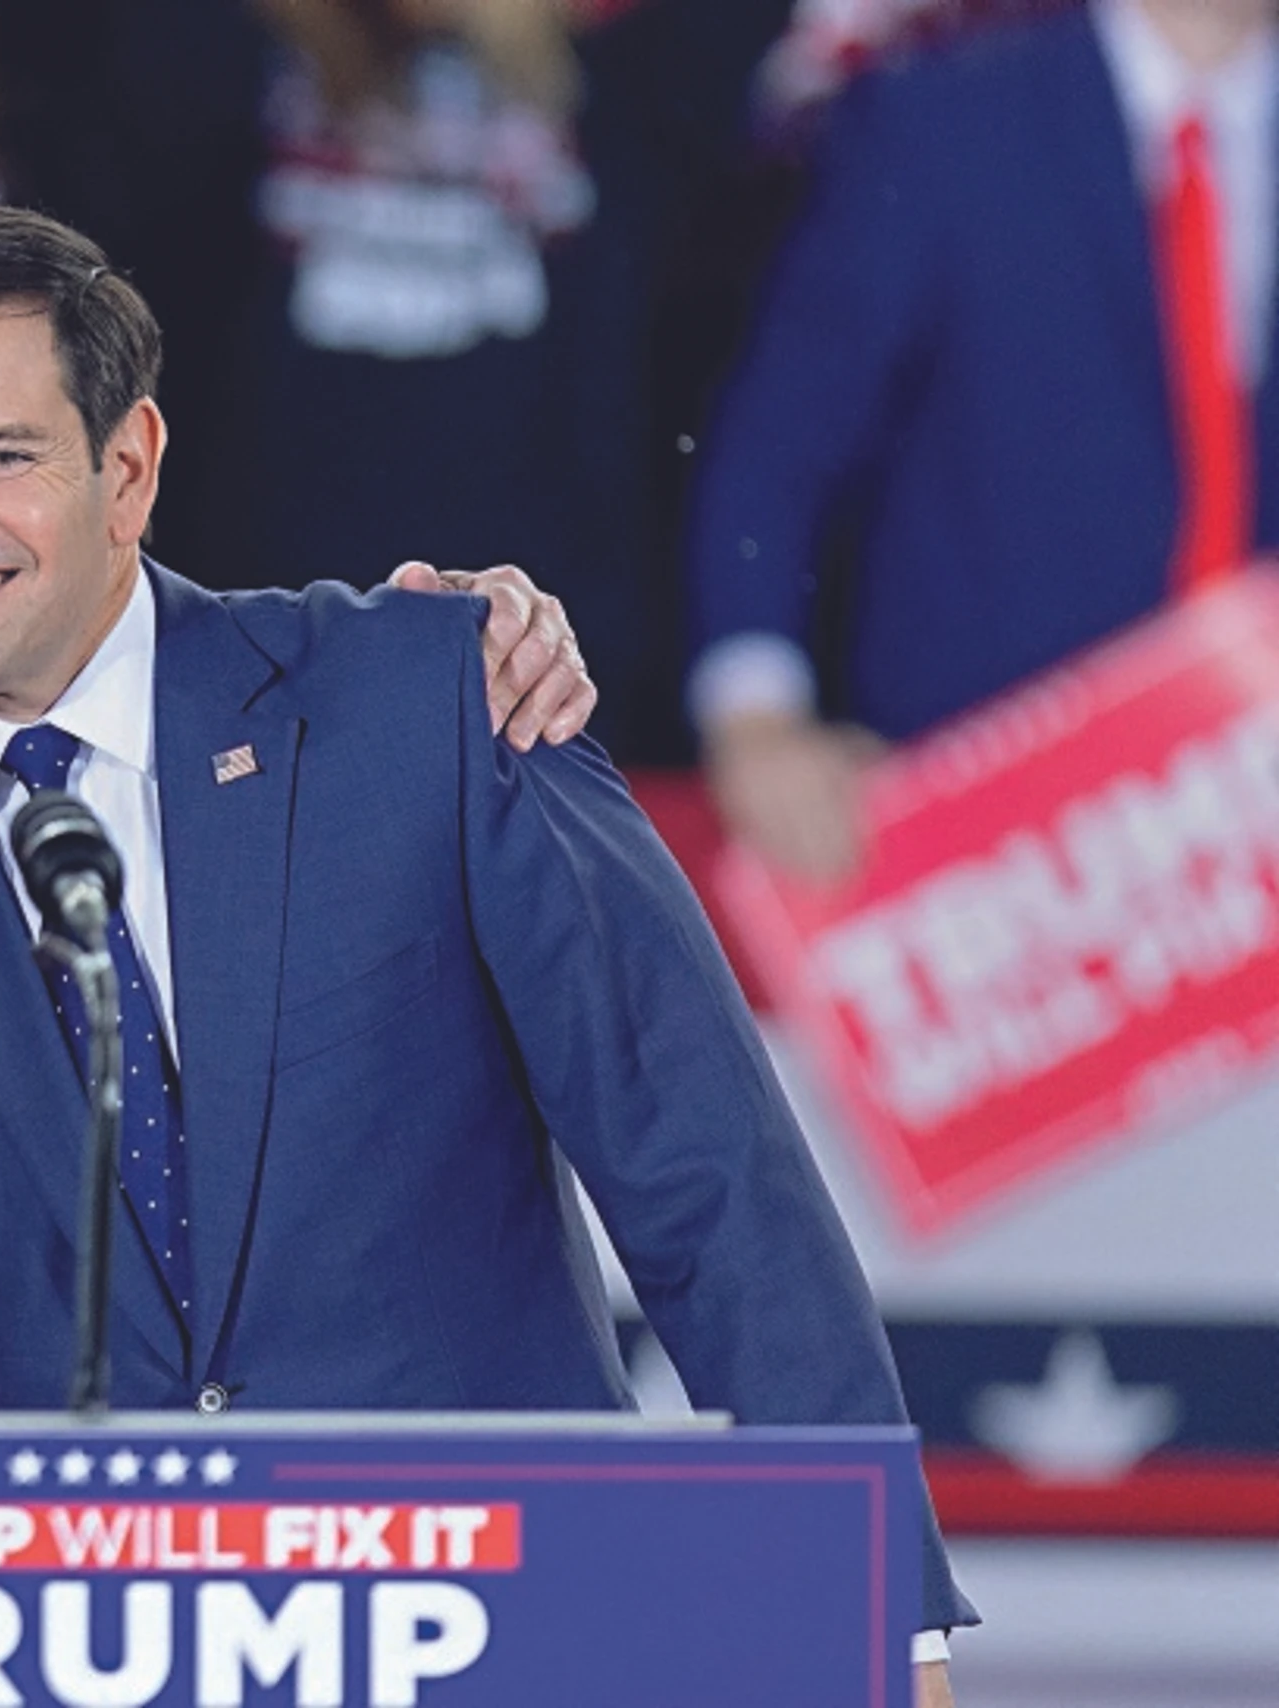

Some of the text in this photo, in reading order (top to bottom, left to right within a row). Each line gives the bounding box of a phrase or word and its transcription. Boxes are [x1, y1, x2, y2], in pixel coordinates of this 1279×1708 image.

[48, 1506, 246, 1568] WILL
[264, 1506, 394, 1568] FIX
[410, 1506, 490, 1568] IT
